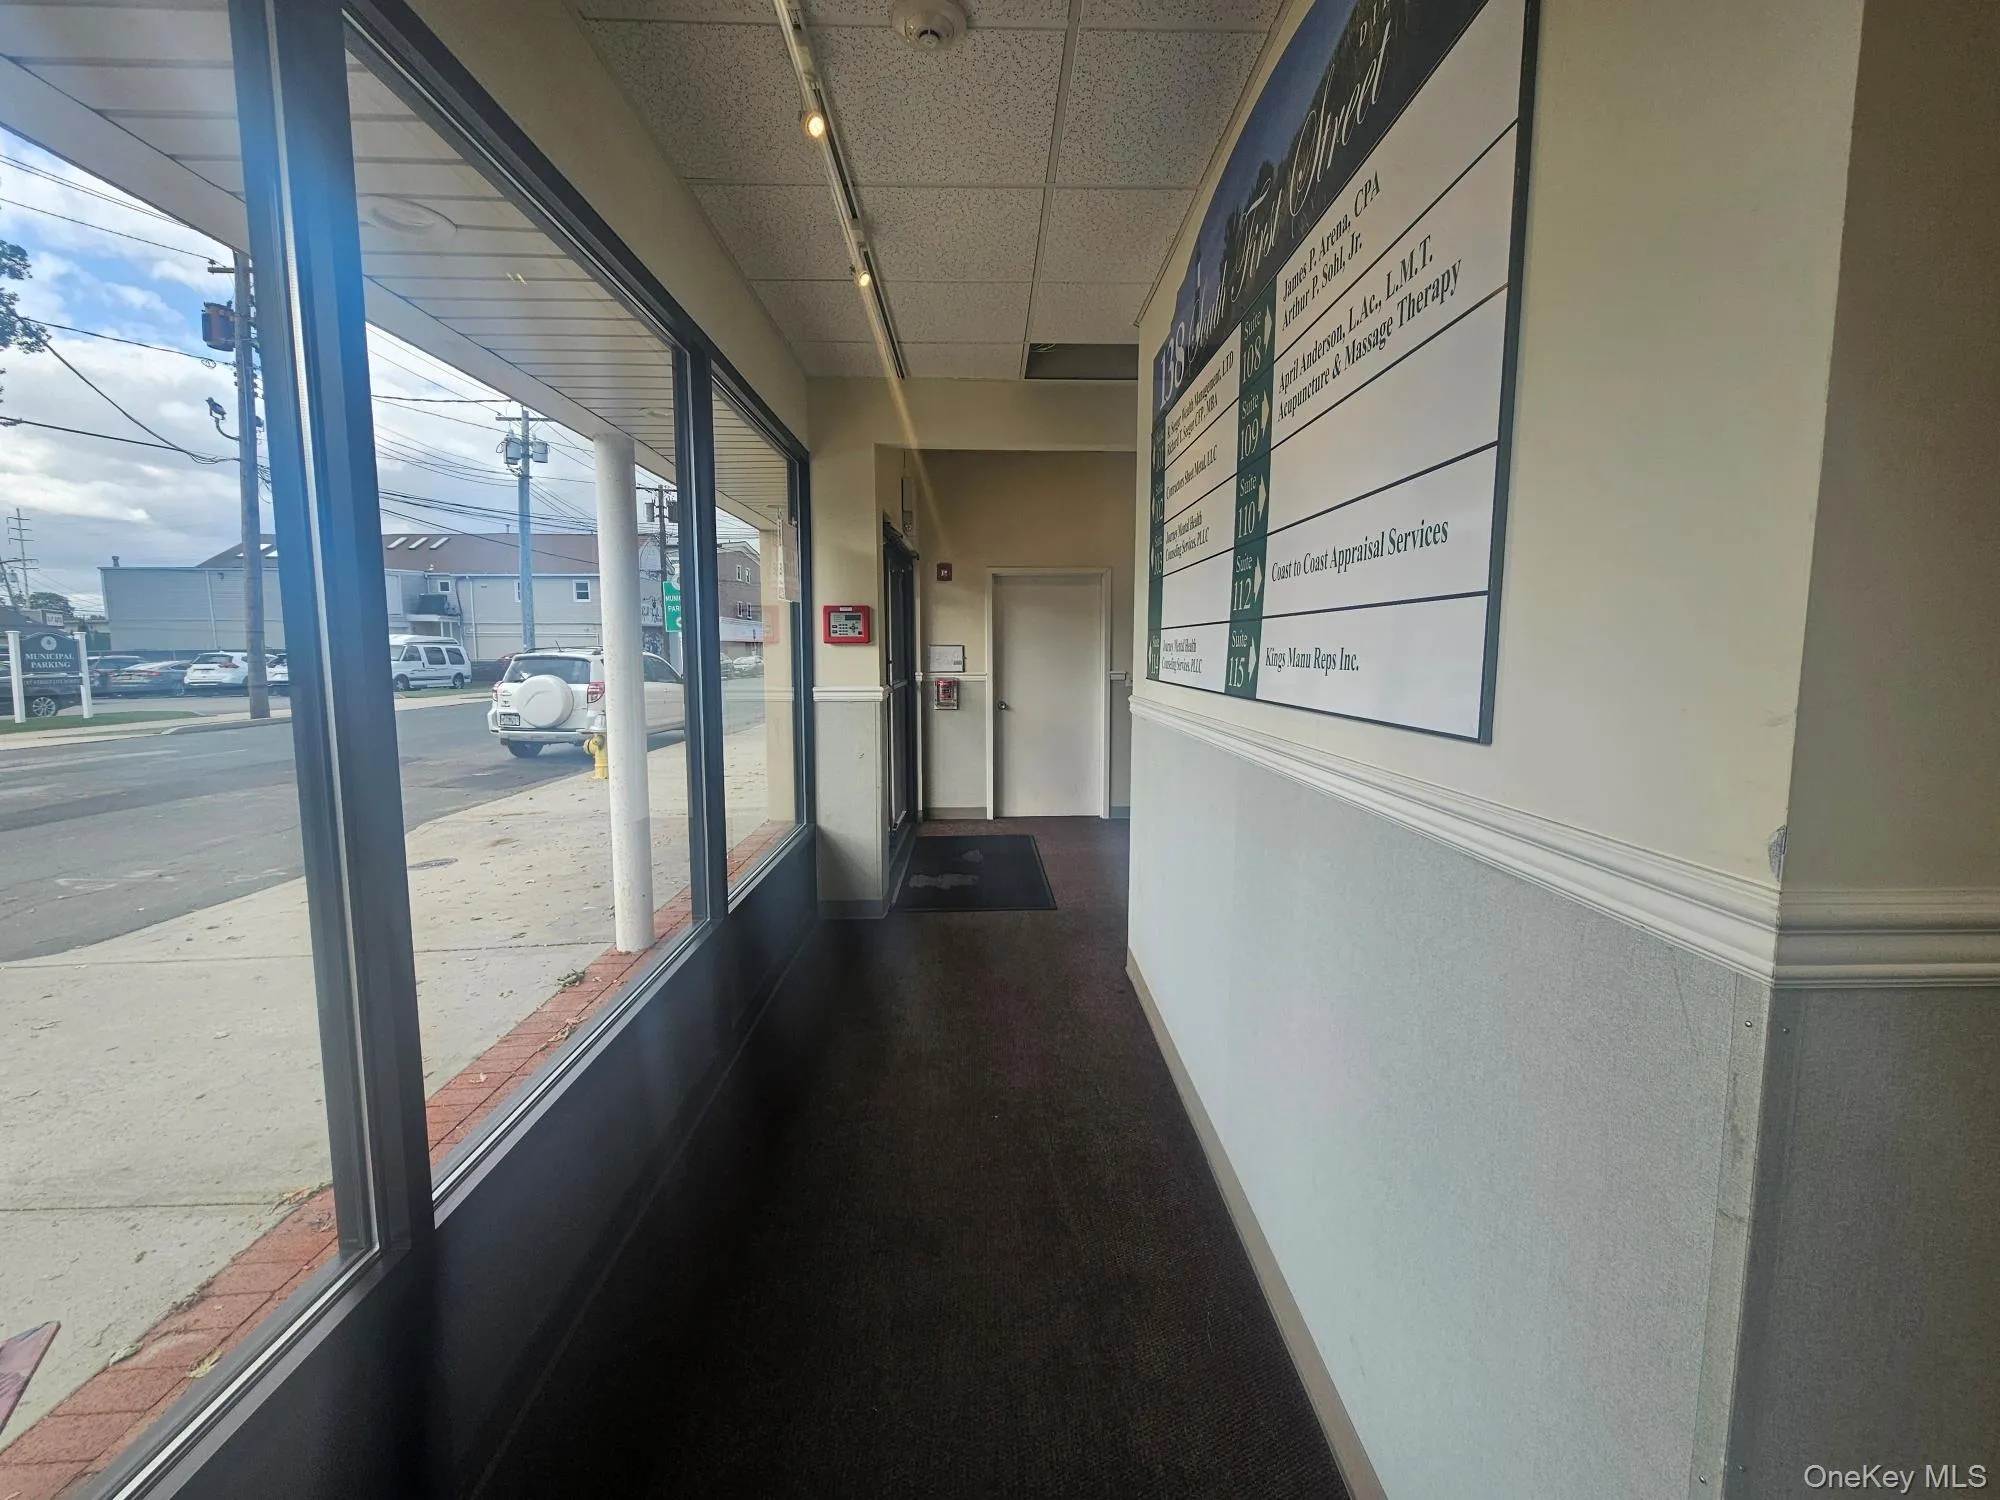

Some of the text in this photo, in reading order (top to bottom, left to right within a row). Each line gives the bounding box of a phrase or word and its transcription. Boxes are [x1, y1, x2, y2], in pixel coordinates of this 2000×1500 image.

[1160, 18, 1391, 410] 138 South First Street
[1283, 169, 1380, 302] James P. Arena, CPA
[1282, 232, 1362, 331] Arthur P. Sohl, Jr.
[1244, 311, 1262, 341] Suite
[1279, 358, 1299, 395] April
[1300, 323, 1346, 375] Anderson,
[1386, 235, 1433, 302] L.M.T.
[1277, 258, 1462, 422] Acupuncture & Massage Therapy
[1222, 351, 1234, 377] LTD
[1242, 335, 1262, 385] 108
[1242, 393, 1259, 420] Suite
[1207, 444, 1217, 466] LLC
[1240, 418, 1259, 462] 109
[1240, 473, 1257, 497] Suite
[1238, 501, 1255, 539] 110
[1236, 555, 1253, 573] Suite
[1272, 519, 1449, 582] Coast to Coast Appraisal Services
[1233, 577, 1252, 611] 112
[1231, 630, 1249, 648] Suite
[25, 653, 74, 661] MUNICIPAL
[1228, 657, 1245, 687] 115
[1265, 647, 1359, 676] Kings Manu Reps Inc.
